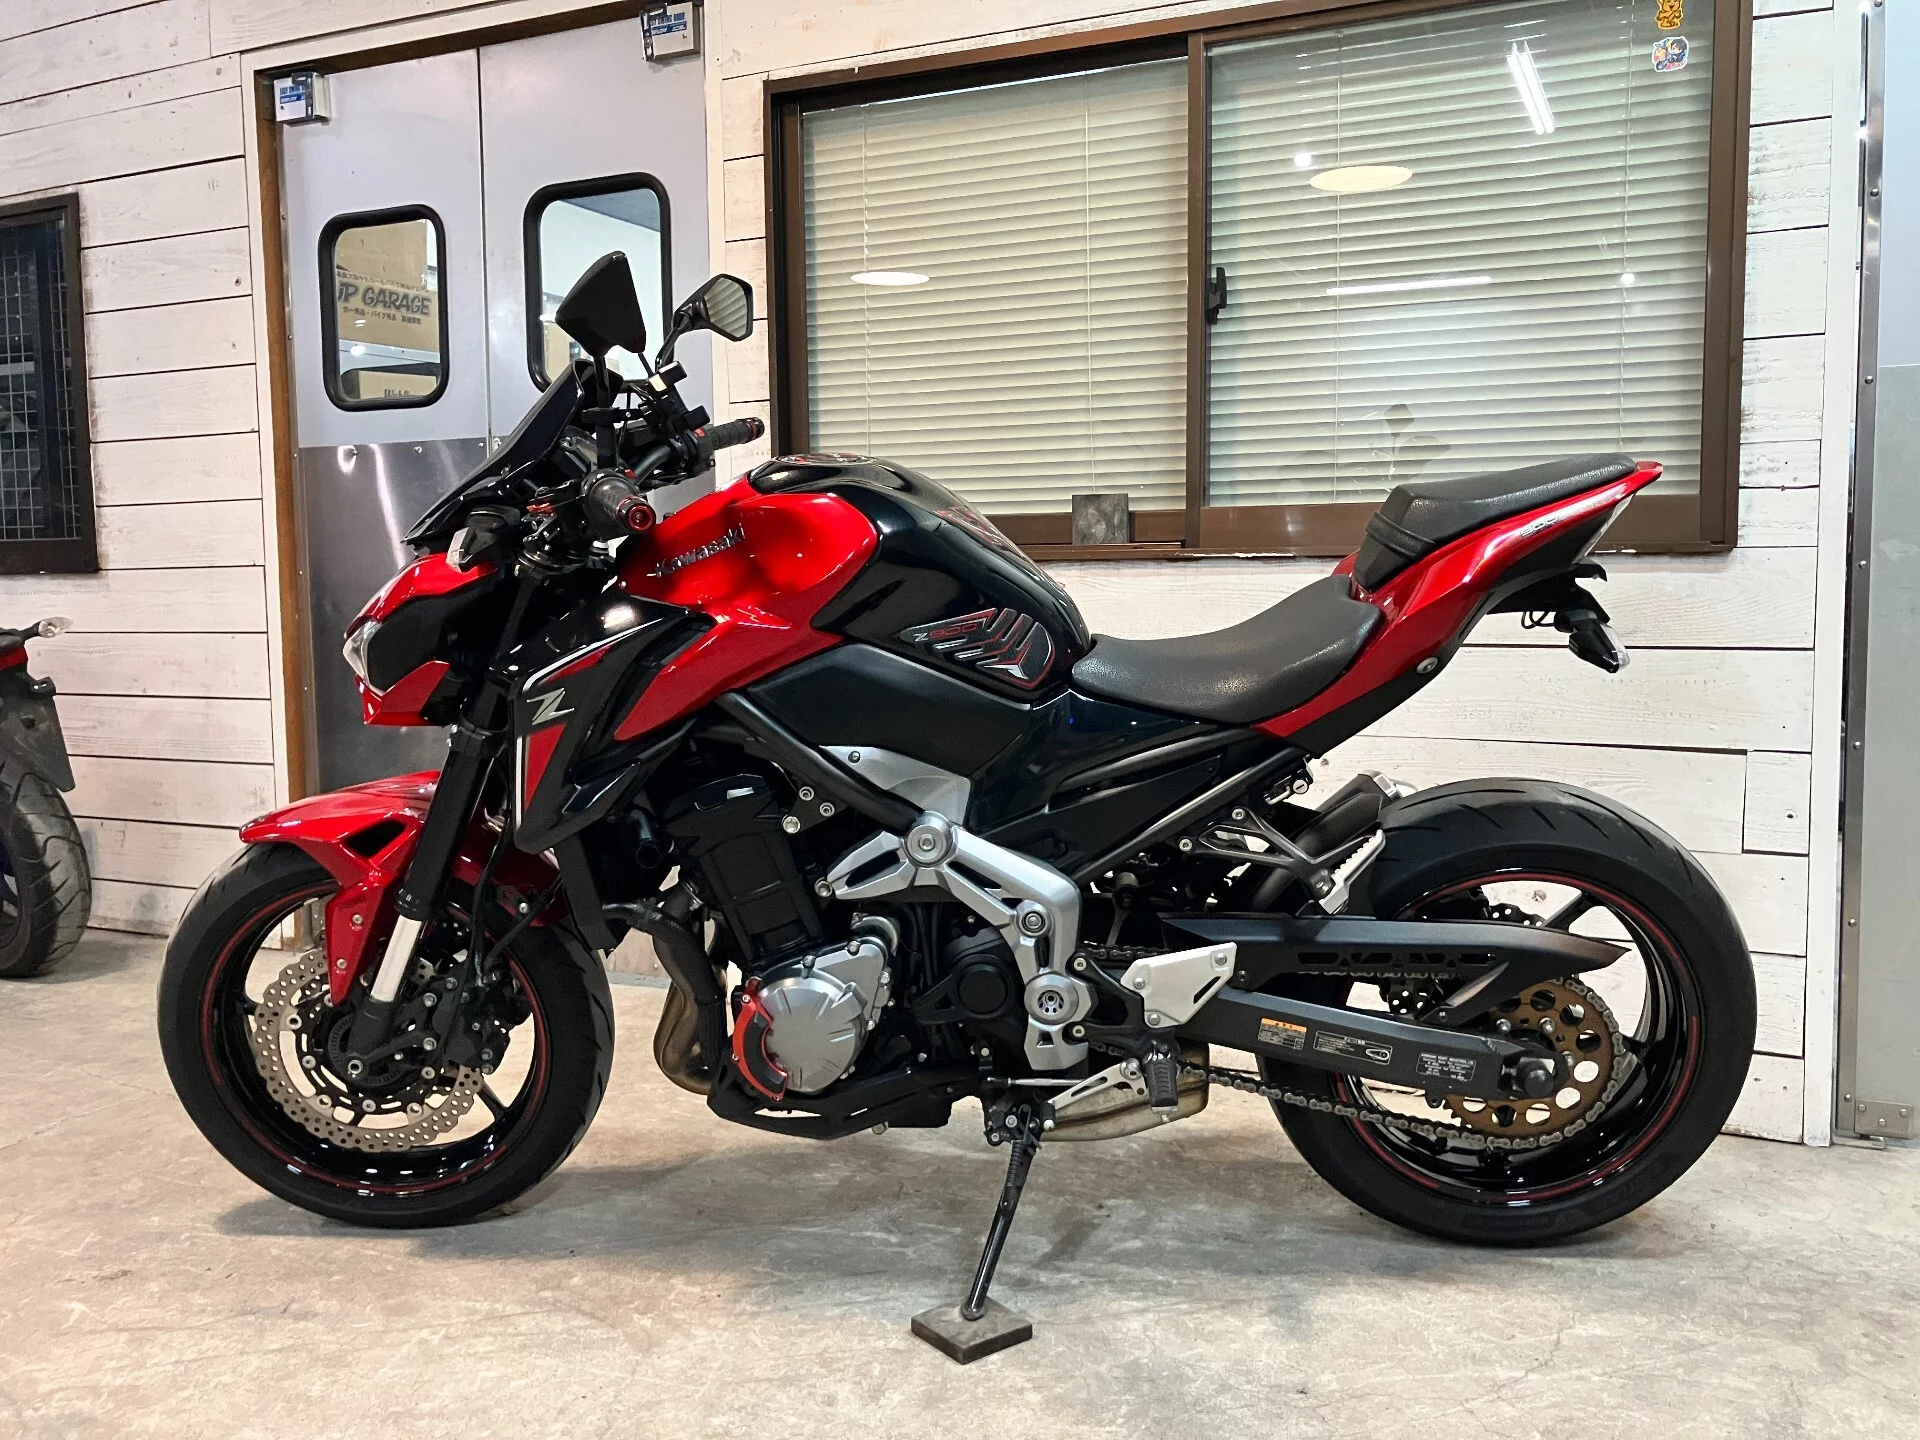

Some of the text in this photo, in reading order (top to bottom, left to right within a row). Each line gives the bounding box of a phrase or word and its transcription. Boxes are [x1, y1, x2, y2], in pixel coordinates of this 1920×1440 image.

[362, 284, 433, 317] GARAGE
[647, 522, 746, 578] Kawasaki
[527, 687, 575, 725] Z
